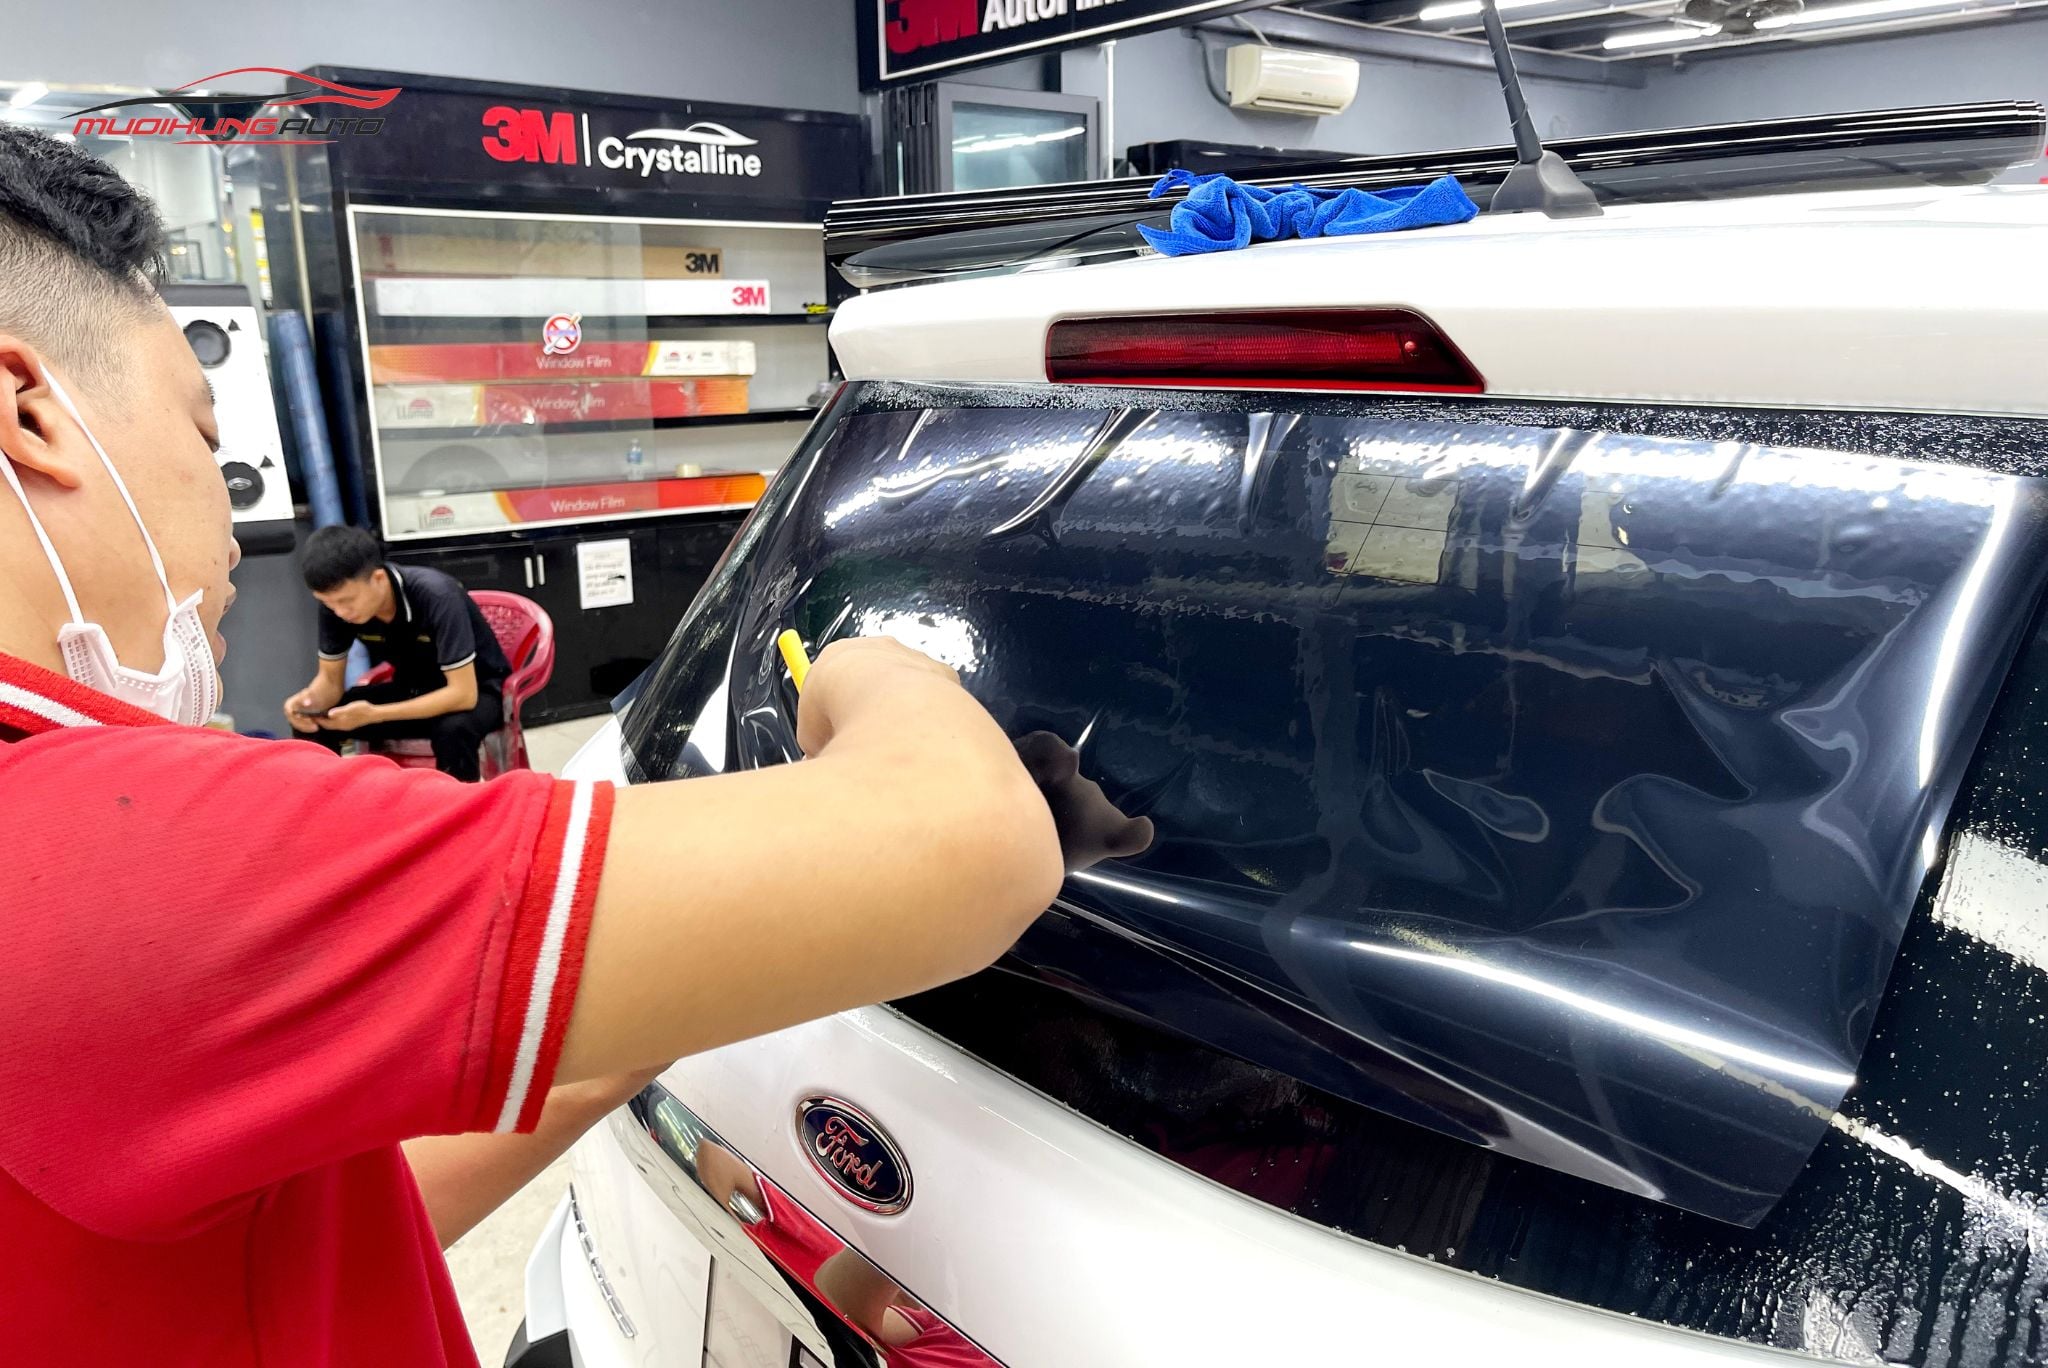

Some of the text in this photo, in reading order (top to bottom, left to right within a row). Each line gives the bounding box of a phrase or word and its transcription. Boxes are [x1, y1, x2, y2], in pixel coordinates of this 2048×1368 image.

[886, 0, 1126, 53] 3M Auto
[482, 106, 762, 177] 3M Crystalline
[685, 252, 719, 273] 3M
[732, 286, 766, 306] 3M
[536, 354, 612, 369] Window Film
[550, 495, 625, 513] Window Film
[815, 1116, 883, 1190] Ford
